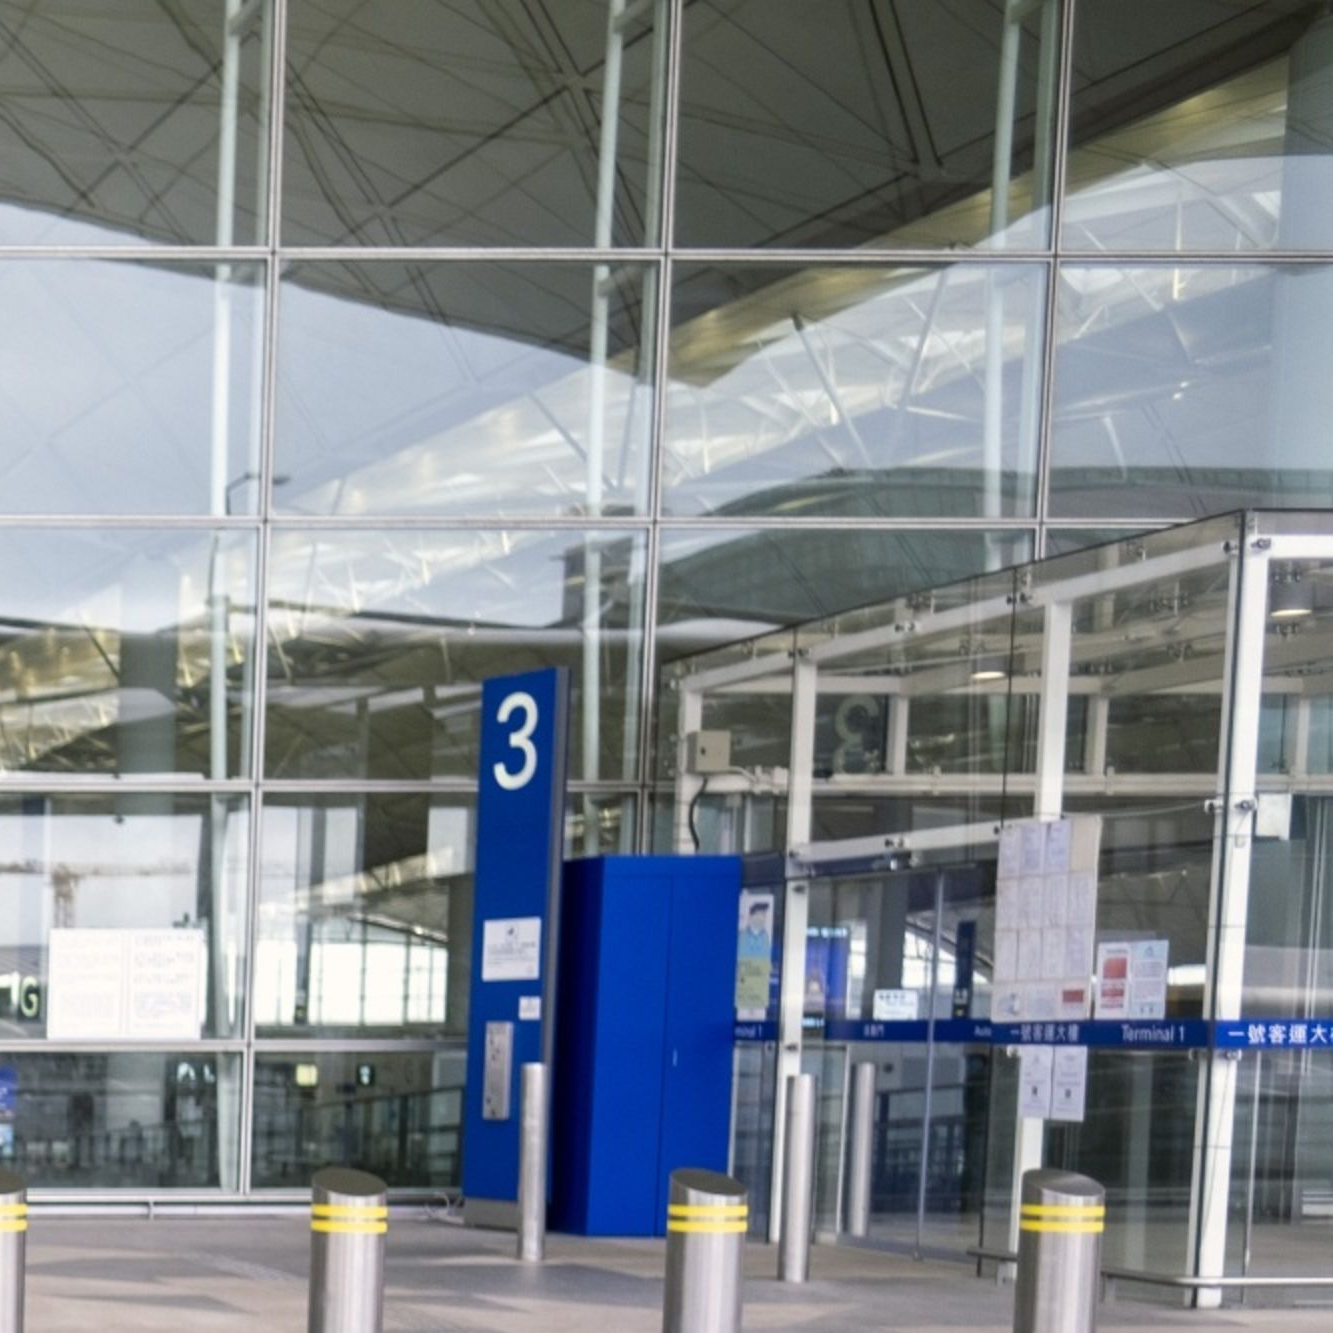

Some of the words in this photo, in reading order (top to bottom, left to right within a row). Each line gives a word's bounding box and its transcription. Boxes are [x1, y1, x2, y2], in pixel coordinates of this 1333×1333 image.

[494, 691, 538, 790] 3
[1122, 1024, 1174, 1042] Terminal
[1179, 1025, 1185, 1042] 1
[1227, 1023, 1333, 1045] 一號客運大
